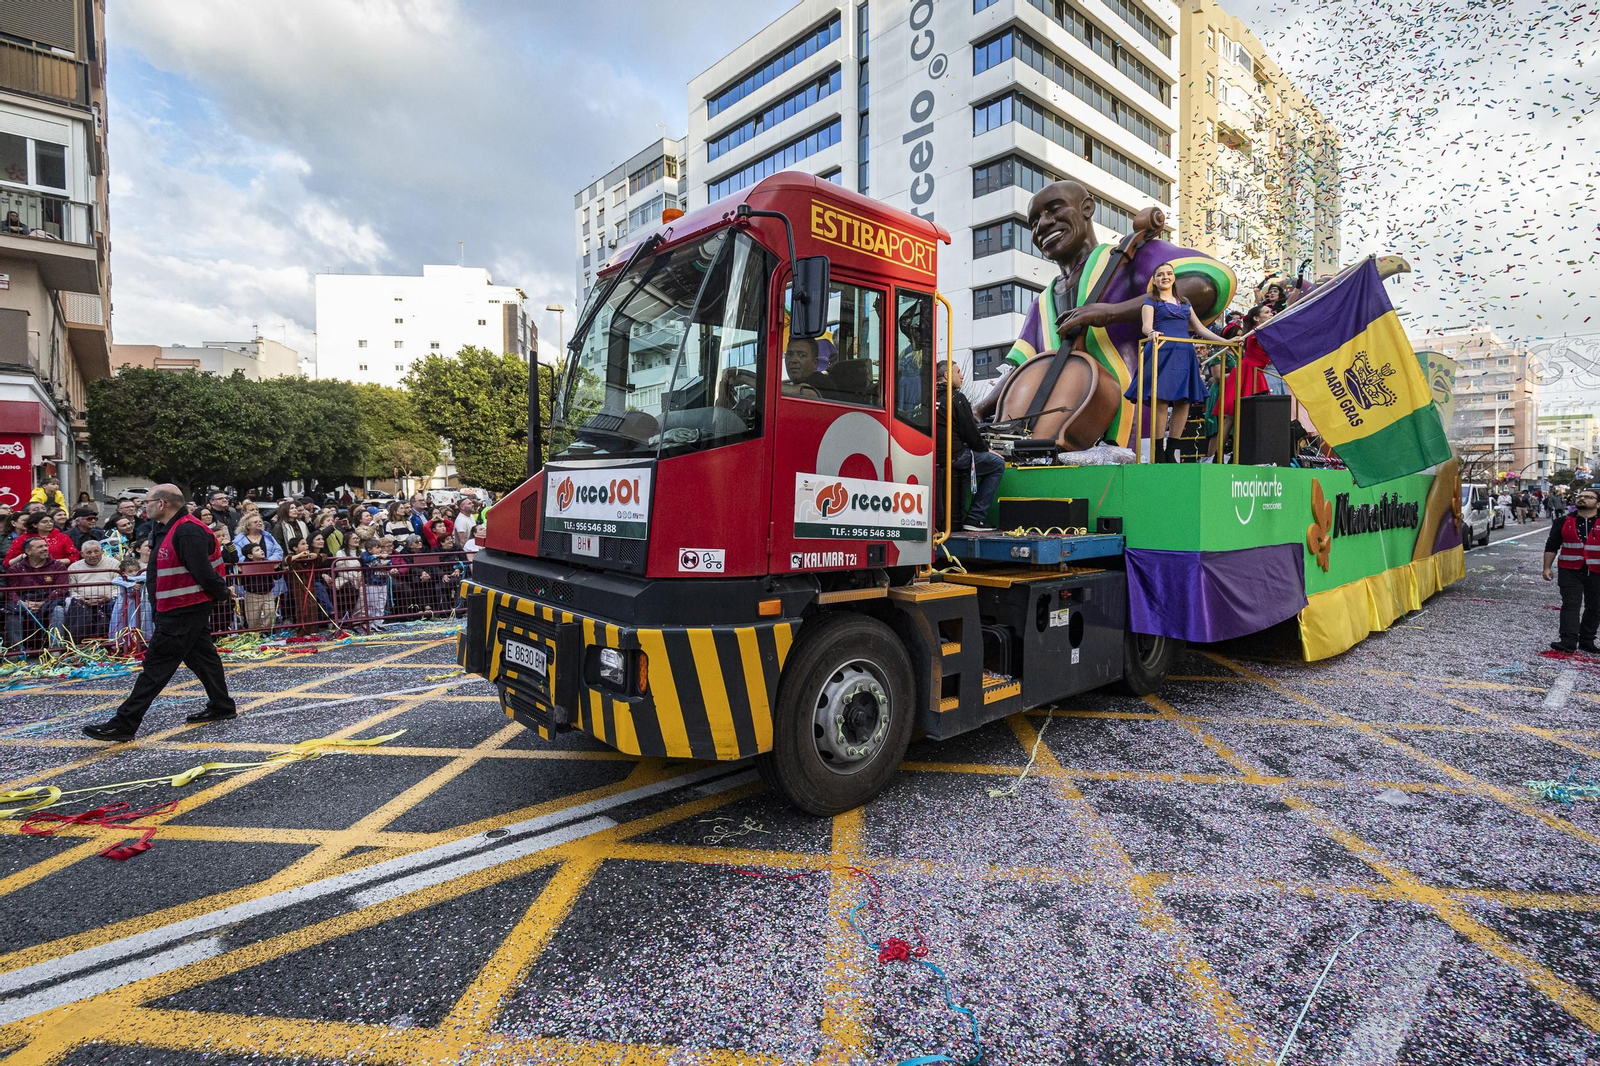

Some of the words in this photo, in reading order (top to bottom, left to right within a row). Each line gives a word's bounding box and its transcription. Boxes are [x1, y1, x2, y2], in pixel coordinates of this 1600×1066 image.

[811, 204, 936, 271] ESTIBAPORT
[1323, 366, 1348, 401] MARDI
[1339, 398, 1364, 428] GRAS
[575, 478, 640, 506] recoSOL
[851, 491, 923, 515] recoSOL
[1231, 473, 1283, 525] imaginarte
[576, 522, 587, 531] 956
[587, 523, 602, 532] 546
[602, 524, 617, 533] 388
[830, 527, 850, 536] TLF.:
[852, 528, 868, 537] 956
[869, 529, 885, 537] 546
[886, 529, 901, 538] 388
[803, 551, 845, 568] KALMAR
[845, 553, 857, 566] T2i
[507, 643, 513, 659] E
[515, 645, 534, 666] 8630
